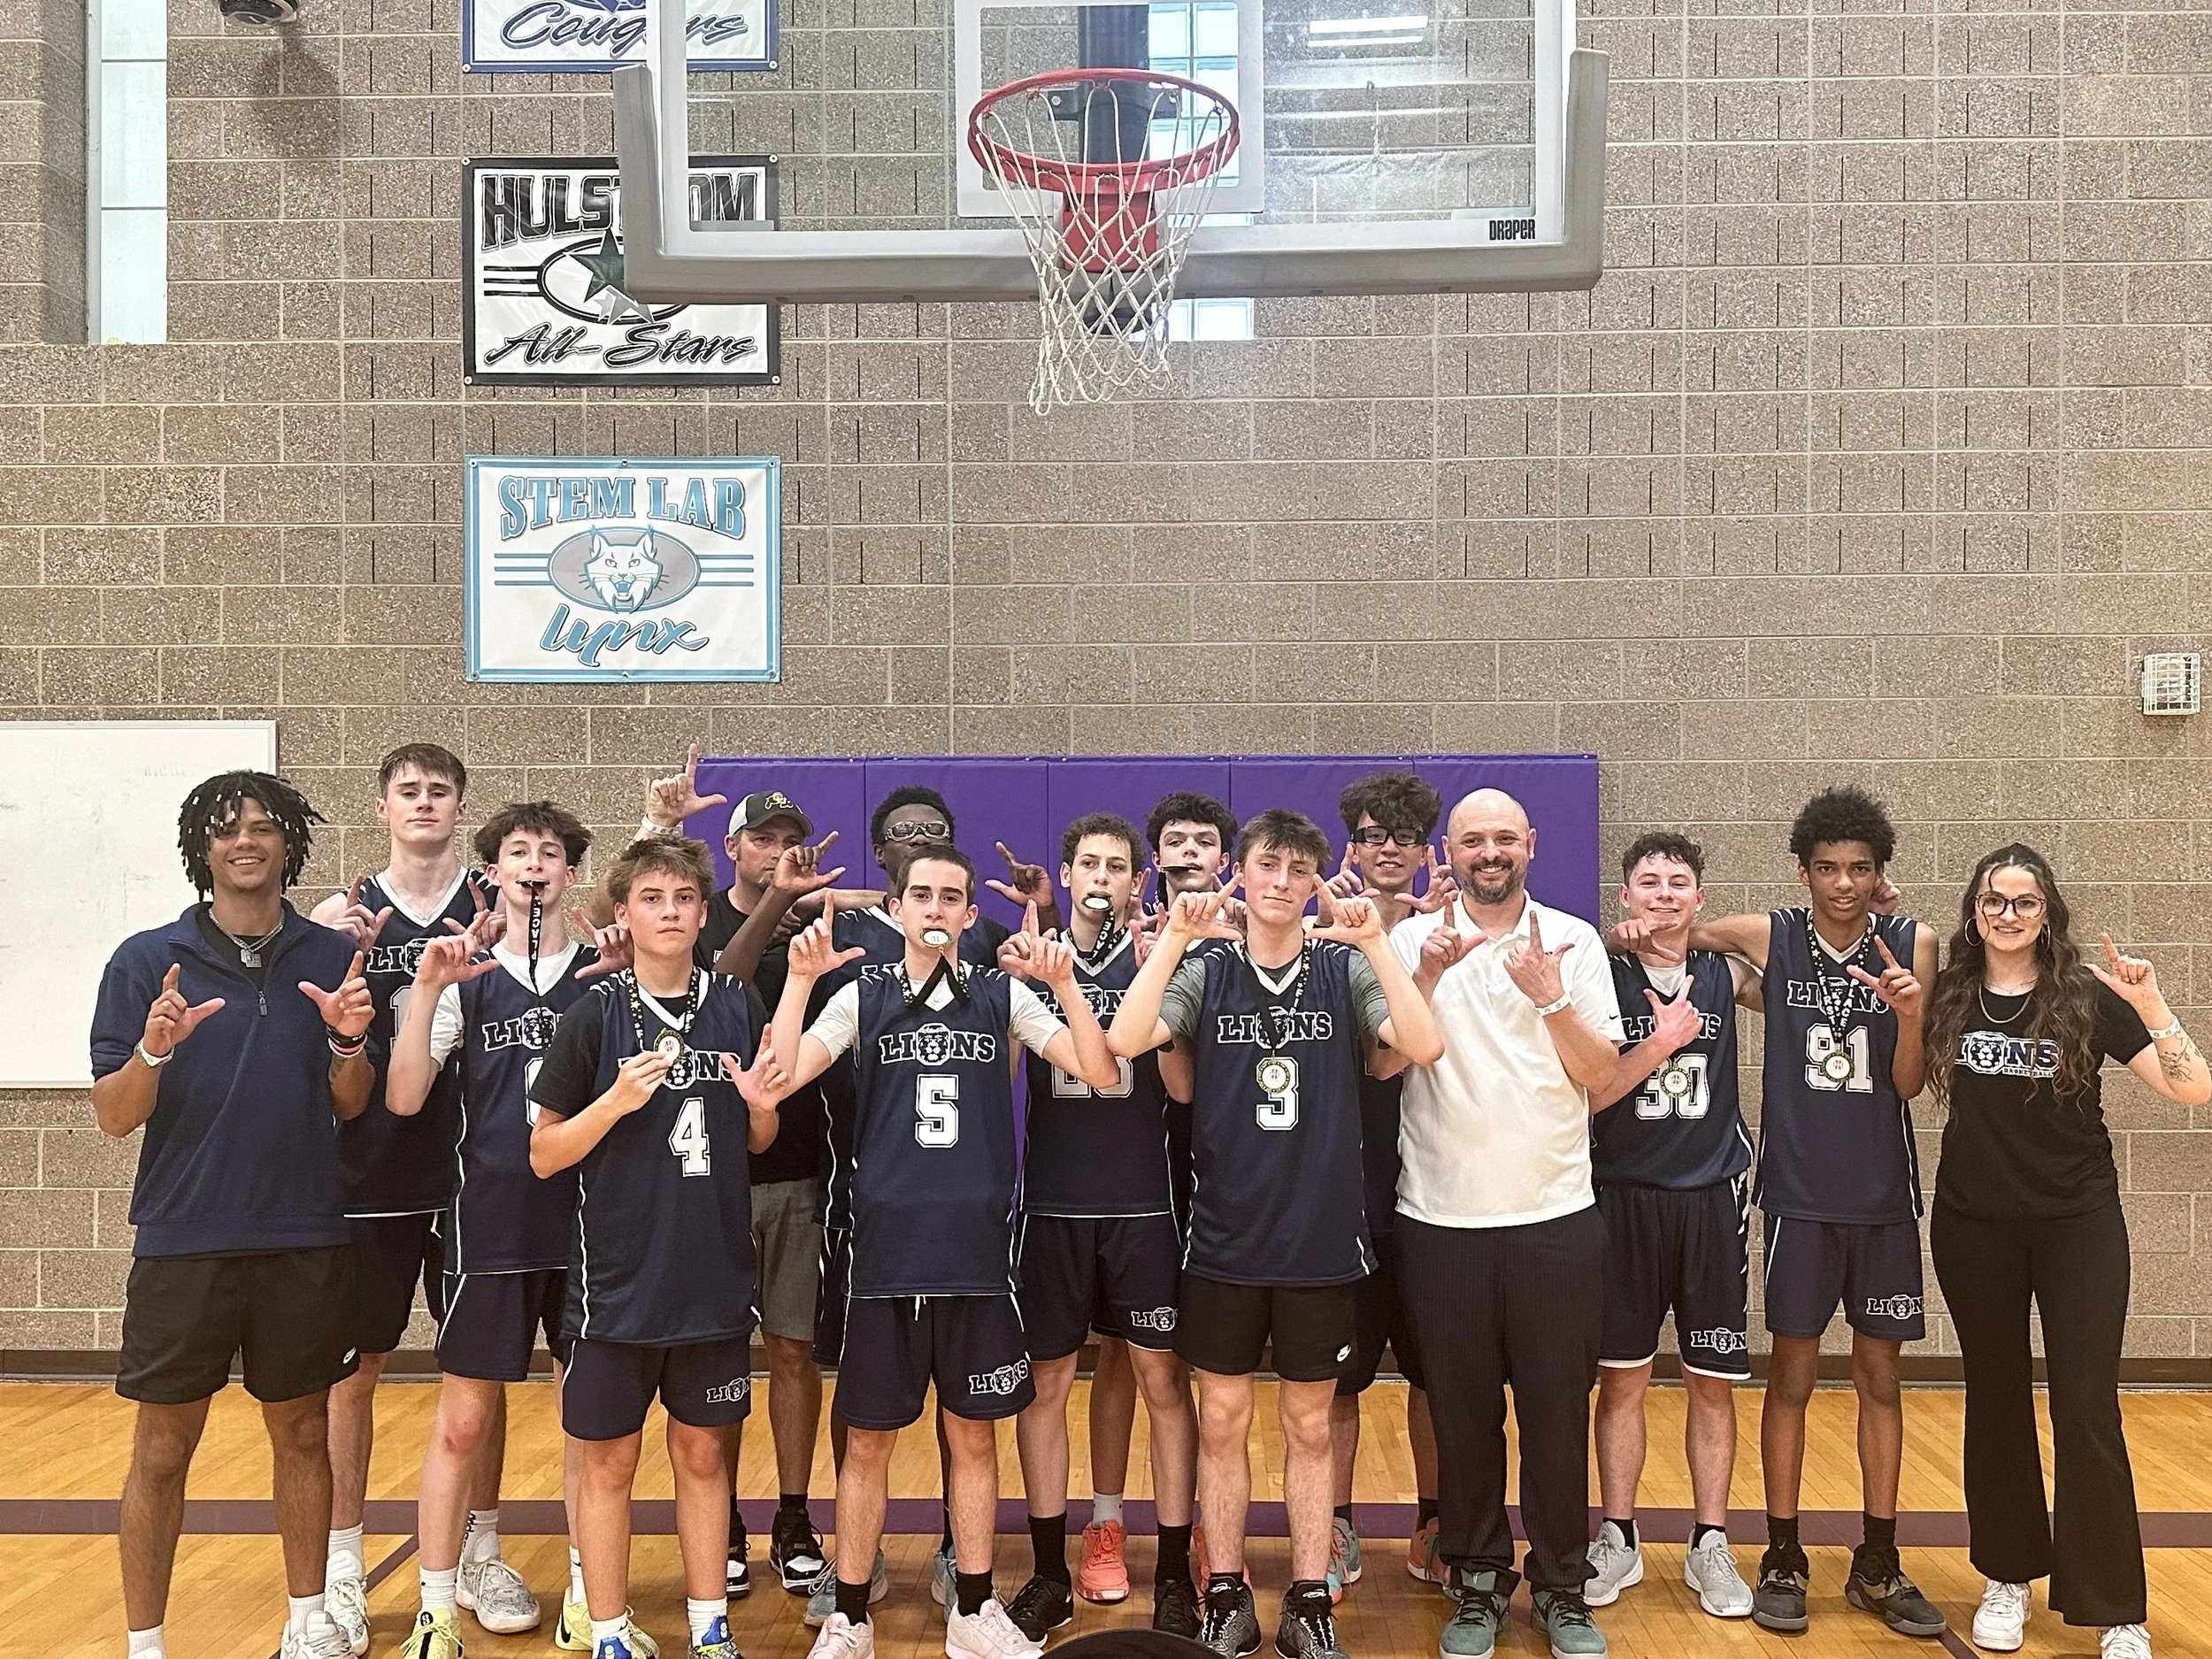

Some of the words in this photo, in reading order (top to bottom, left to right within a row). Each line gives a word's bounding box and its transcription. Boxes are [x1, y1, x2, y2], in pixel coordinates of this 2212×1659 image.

[500, 2, 749, 59] Cougrs
[480, 173, 758, 250] HULSOM
[1489, 219, 1535, 241] DRAPER
[498, 475, 636, 541] STEM
[647, 477, 747, 540] LAB
[1819, 976, 1837, 1025] FIRST
[1839, 979, 1859, 1026] PLACE
[482, 1007, 564, 1052] LIO
[879, 1023, 995, 1066] LIONS
[1954, 1031, 2060, 1074] IONS
[1805, 1023, 1873, 1093] 91
[915, 1074, 958, 1148] 5
[668, 1097, 710, 1177] 4
[1866, 1294, 1923, 1319] LION
[1691, 1327, 1747, 1354] LION
